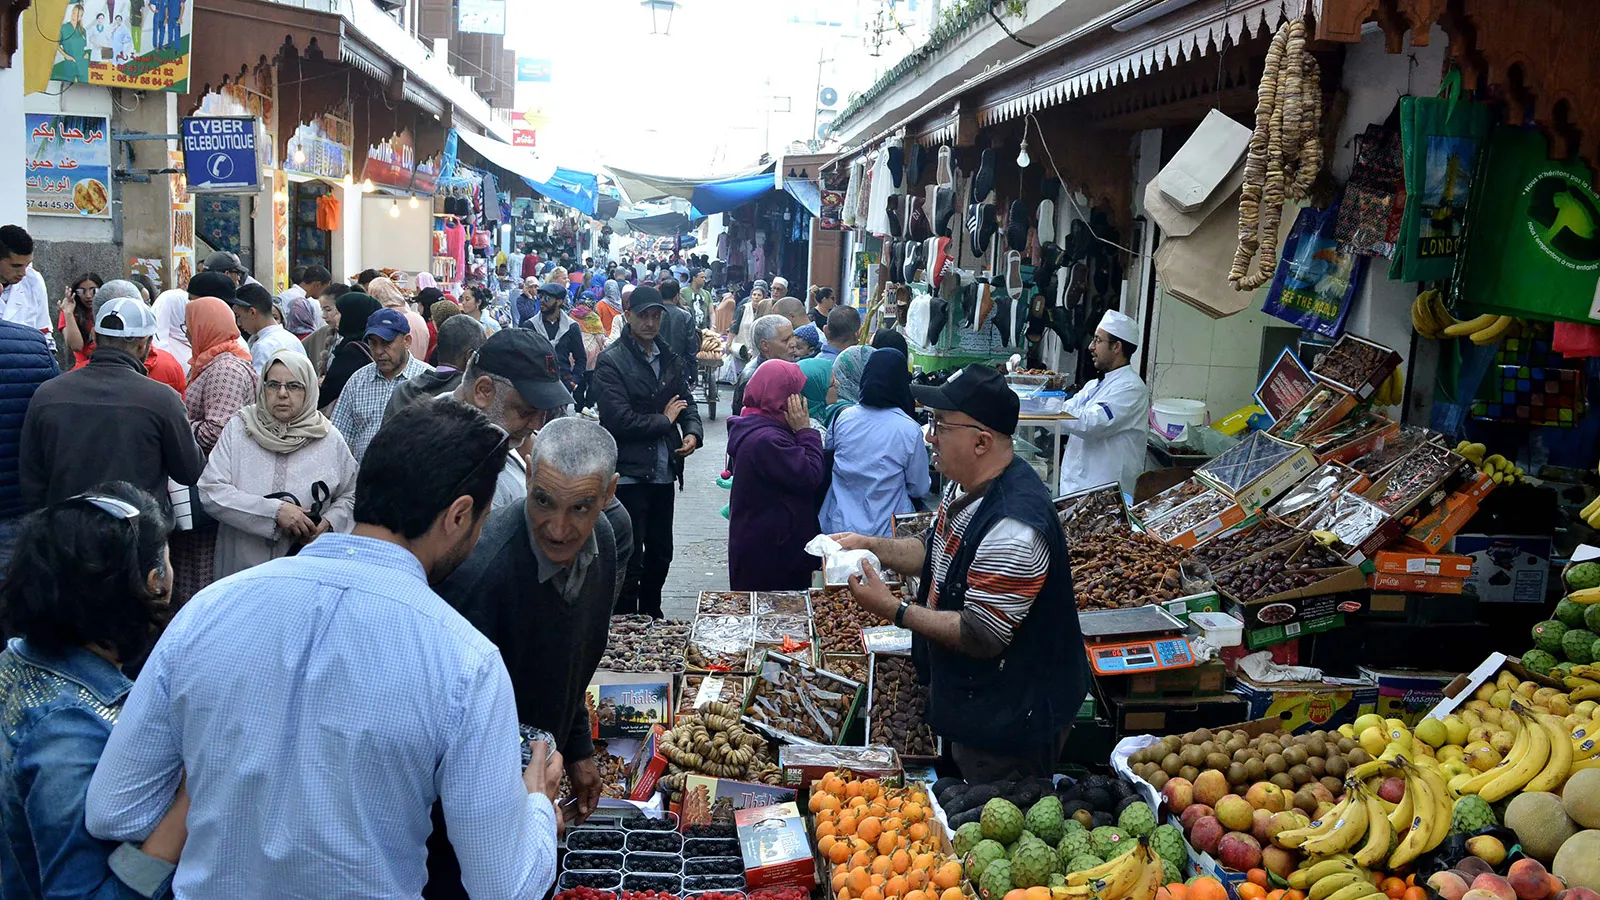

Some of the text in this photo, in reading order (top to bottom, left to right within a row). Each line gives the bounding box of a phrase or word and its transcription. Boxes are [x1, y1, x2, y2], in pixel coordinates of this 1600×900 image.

[32, 121, 103, 145] مرحبا بكم
[190, 119, 243, 134] CYBER
[58, 157, 78, 169] عند
[38, 200, 49, 208] 44
[51, 201, 62, 210] 45
[63, 202, 75, 210] 99
[1281, 289, 1338, 317] SEE THE WORLD
[621, 689, 658, 705] Thalis
